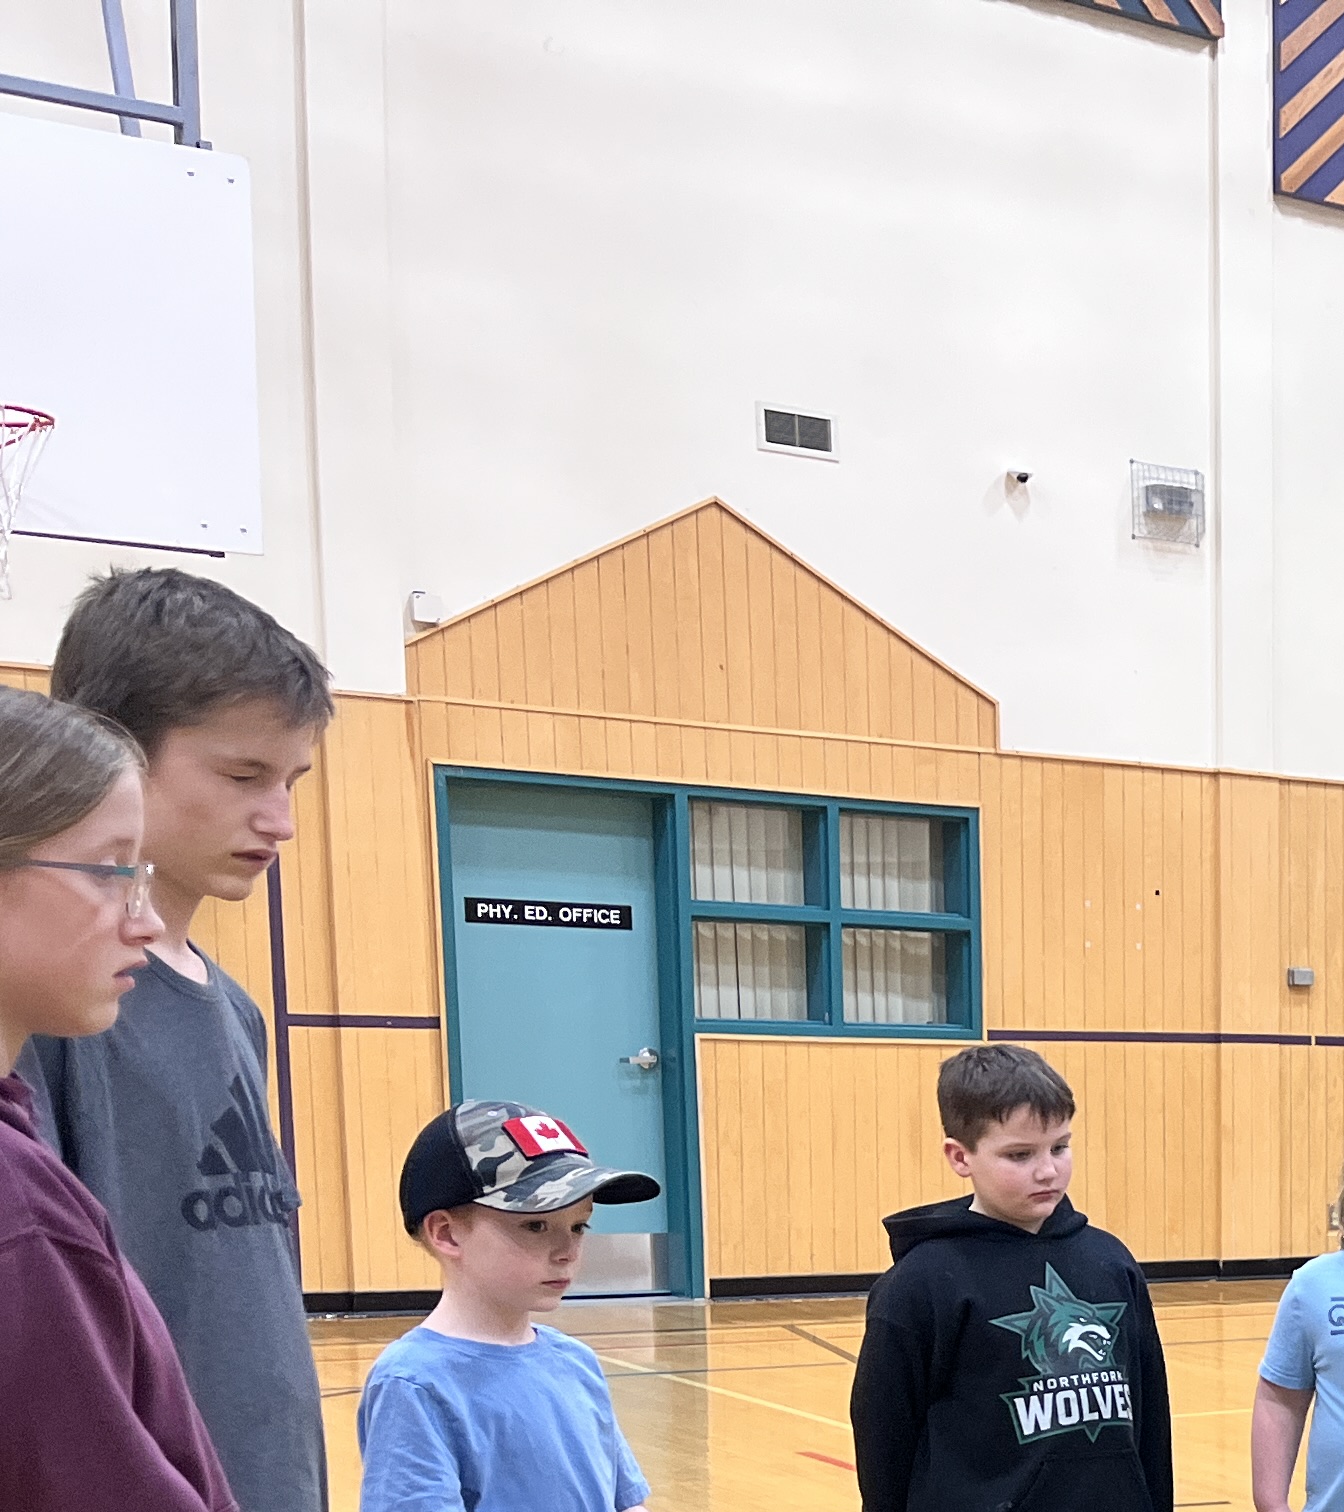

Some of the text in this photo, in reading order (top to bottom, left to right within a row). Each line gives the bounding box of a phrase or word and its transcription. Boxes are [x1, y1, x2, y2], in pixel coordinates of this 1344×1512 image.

[476, 902, 622, 925] PHY. ED. OFFICE
